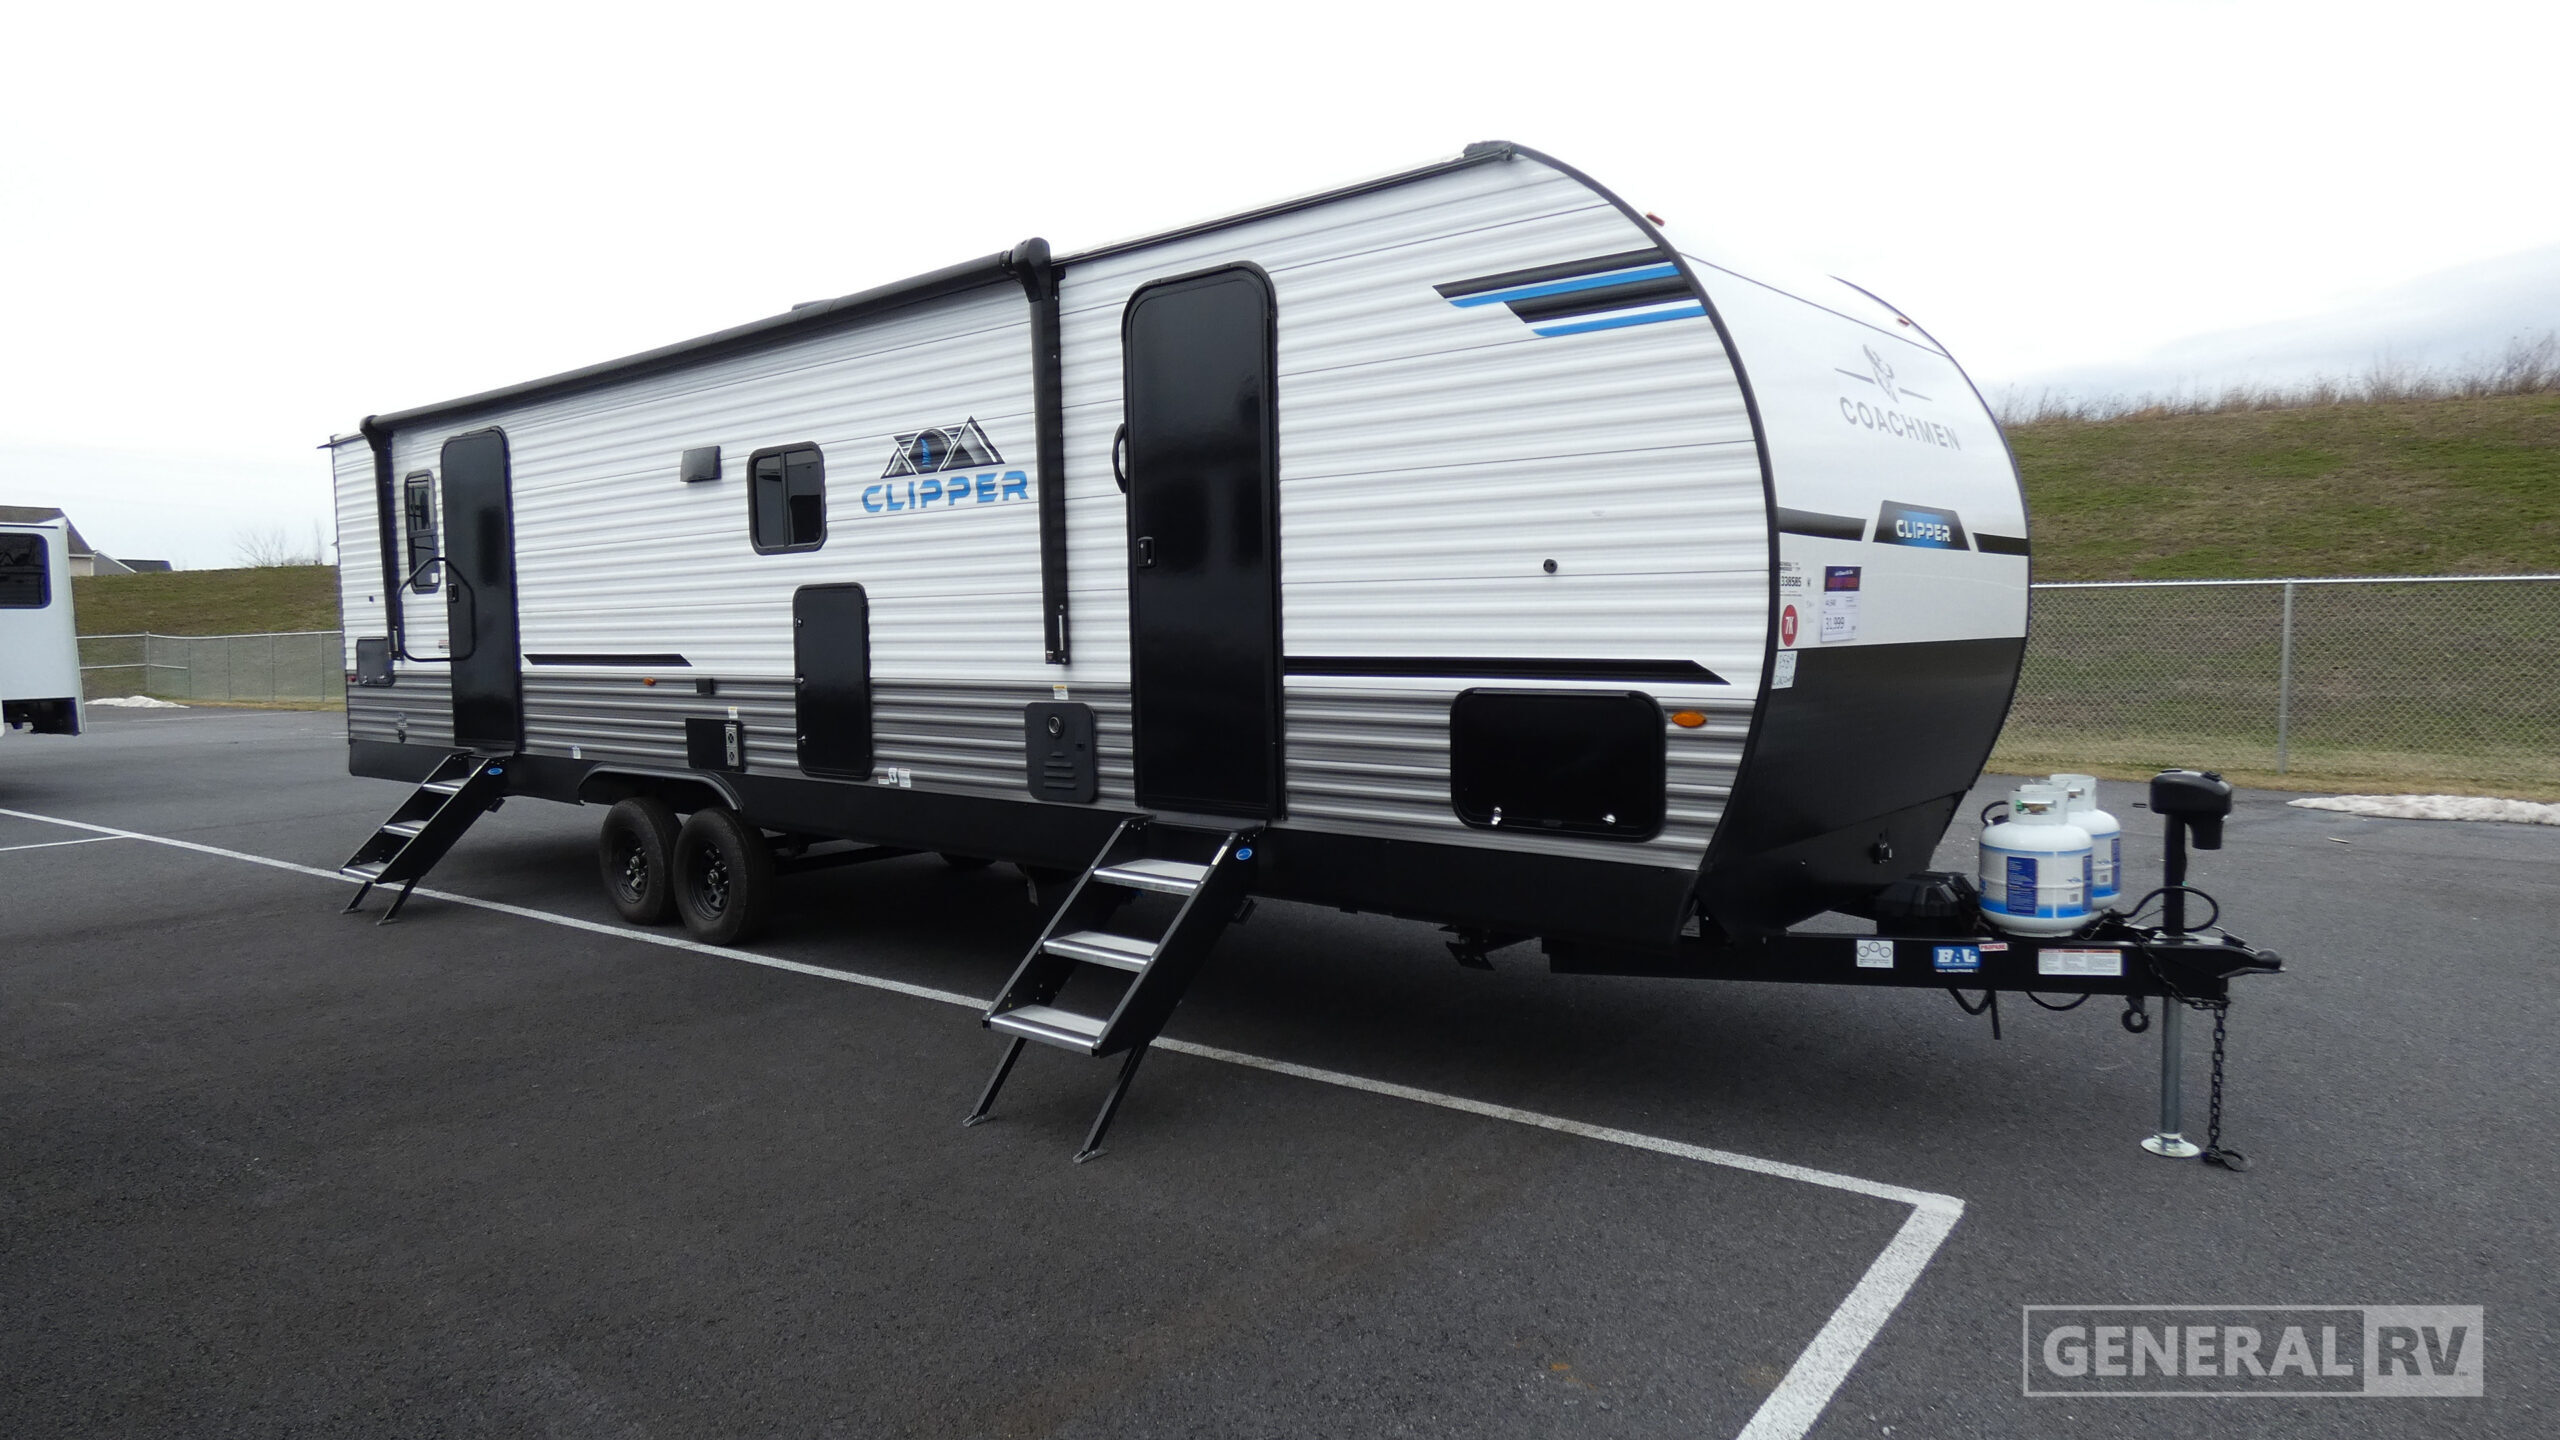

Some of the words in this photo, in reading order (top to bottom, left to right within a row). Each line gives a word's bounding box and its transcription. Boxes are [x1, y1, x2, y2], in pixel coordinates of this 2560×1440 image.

[1839, 396, 1961, 450] COACHMEN
[861, 469, 1029, 513] CLIPPER
[1895, 519, 1952, 542] CLIPPER
